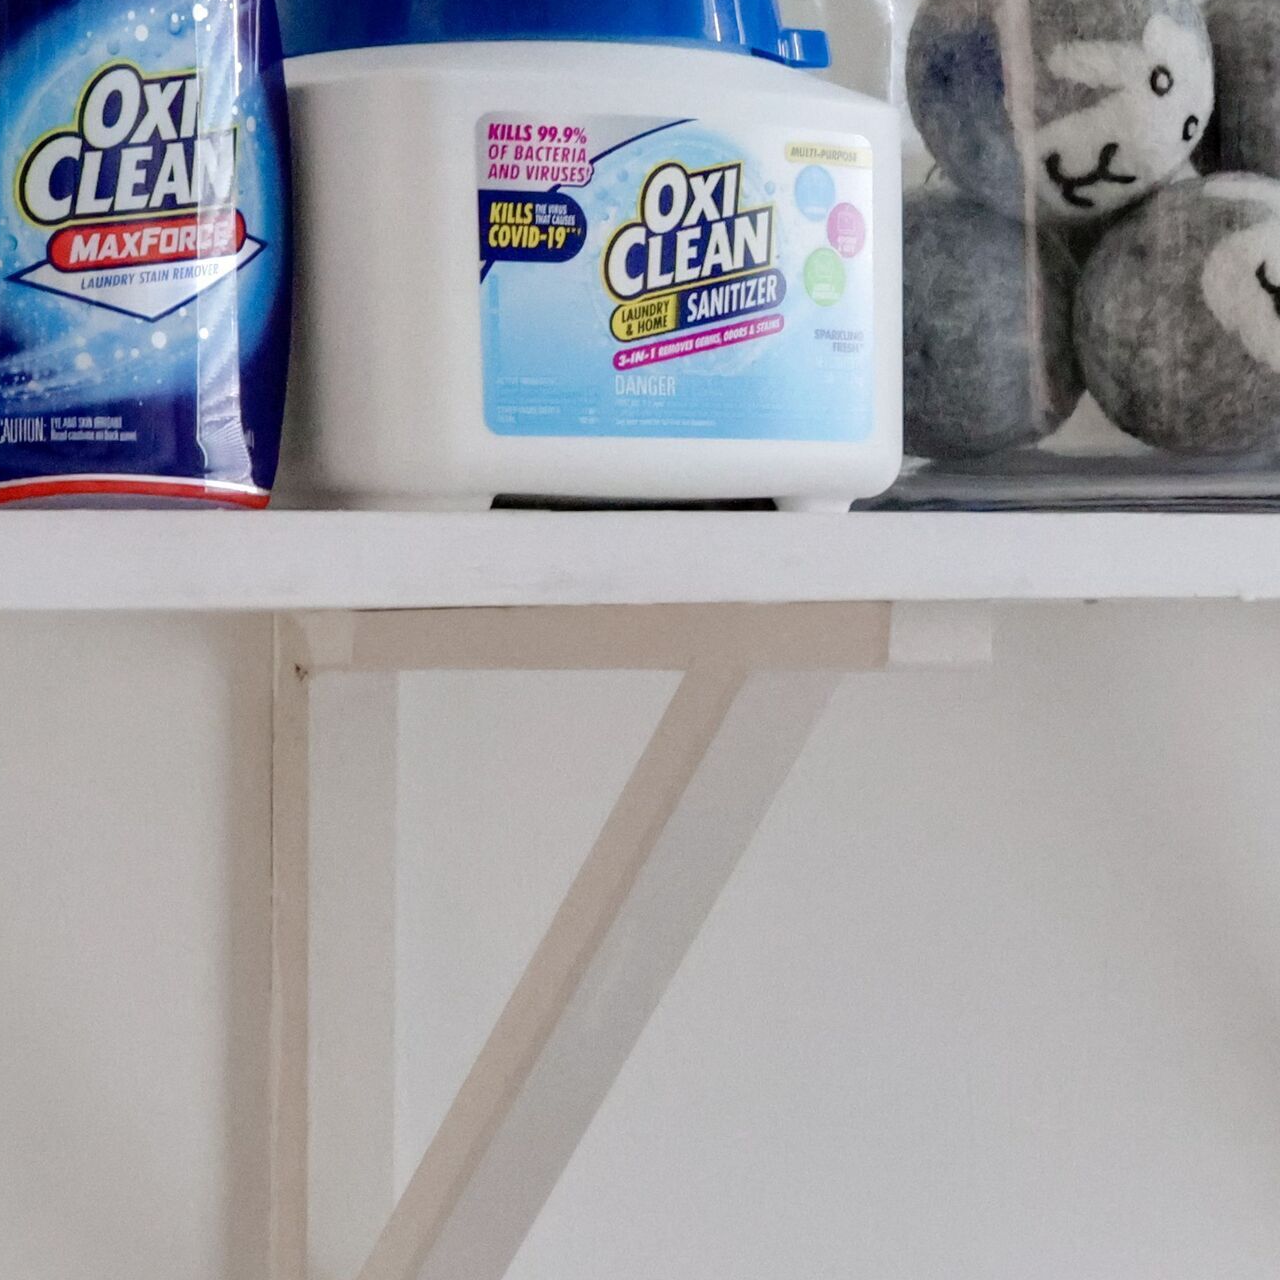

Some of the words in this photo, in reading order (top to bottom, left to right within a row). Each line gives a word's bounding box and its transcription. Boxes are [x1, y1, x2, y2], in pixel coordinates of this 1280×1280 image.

[81, 67, 202, 150] OXI
[487, 123, 533, 142] KILLS
[537, 125, 588, 145] 99.9%
[488, 144, 508, 161] OF
[513, 144, 587, 164] BACTERIA
[790, 145, 858, 163] MULTI-PURPOSE
[23, 132, 236, 222] CLEAN
[487, 163, 521, 180] AND
[643, 166, 739, 235] OXI
[489, 202, 534, 225] KILLS
[69, 220, 232, 264] MAXFORCE
[607, 210, 770, 297] CLEAN
[81, 273, 135, 291] LAUNDRY
[139, 271, 169, 285] STAIN
[172, 263, 219, 280] REMOVER
[687, 274, 778, 323] SANITIZER
[621, 300, 670, 324] LAUNDRY
[625, 324, 634, 337] &
[637, 316, 669, 334] HOME
[614, 374, 677, 397] DANGER
